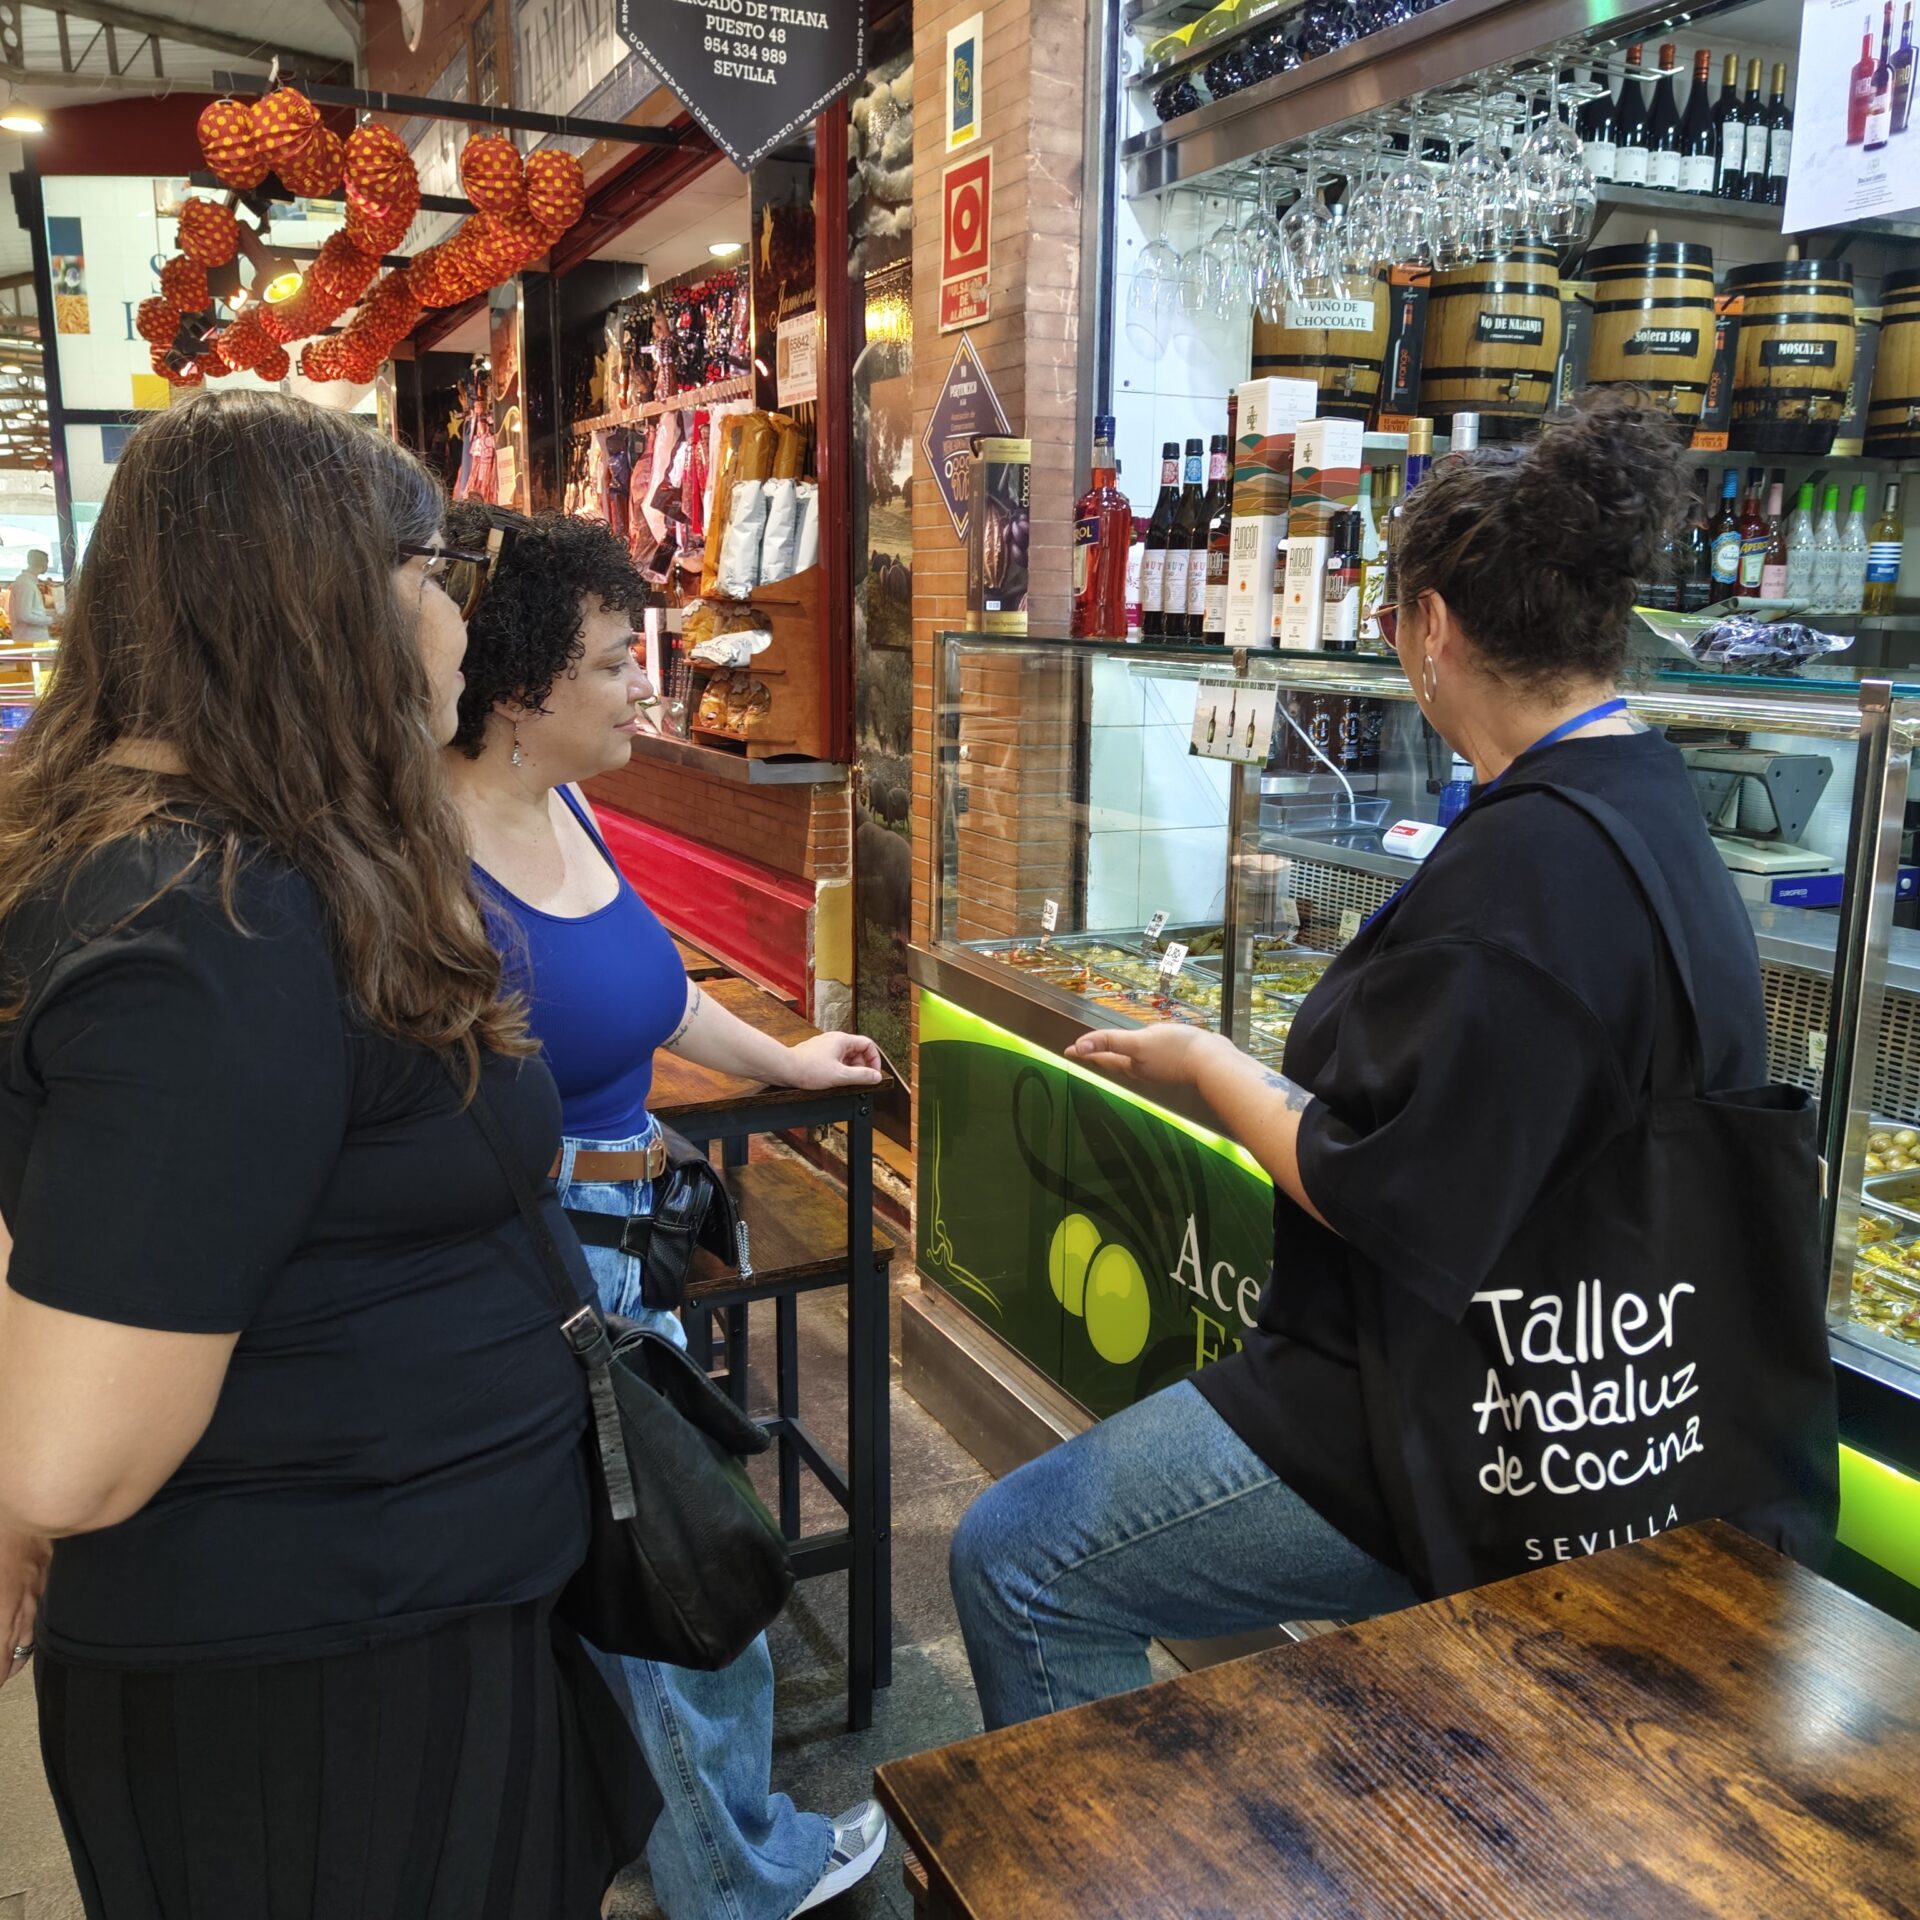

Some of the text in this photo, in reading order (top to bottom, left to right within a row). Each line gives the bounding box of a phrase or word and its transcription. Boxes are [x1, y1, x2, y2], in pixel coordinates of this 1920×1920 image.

[674, 0, 829, 29] CADO DE TRIANA
[706, 14, 787, 43] PUESTO 48
[704, 36, 787, 65] 954 334 989
[629, 32, 690, 101] CONSERVAS
[713, 59, 778, 85] SEVILLA
[798, 72, 856, 122] CONSERVAS
[694, 106, 740, 160] CHACINA
[747, 122, 794, 163] CHACINA
[950, 304, 977, 321] ALARMA
[960, 294, 969, 307] DE
[1309, 301, 1359, 313] VINO DE
[1296, 316, 1367, 328] CHOCOLATE
[1494, 318, 1508, 330] DE
[1669, 331, 1692, 344] 1840
[1022, 467, 1030, 507] chocoa
[1207, 743, 1250, 758] 2 1 3
[1169, 1213, 1263, 1328] Ace
[1471, 1279, 1696, 1366] Taller
[1472, 1362, 1699, 1434] Andaluz
[1479, 1415, 1704, 1496] de Cocina
[1525, 1503, 1678, 1561] SEVILLA
